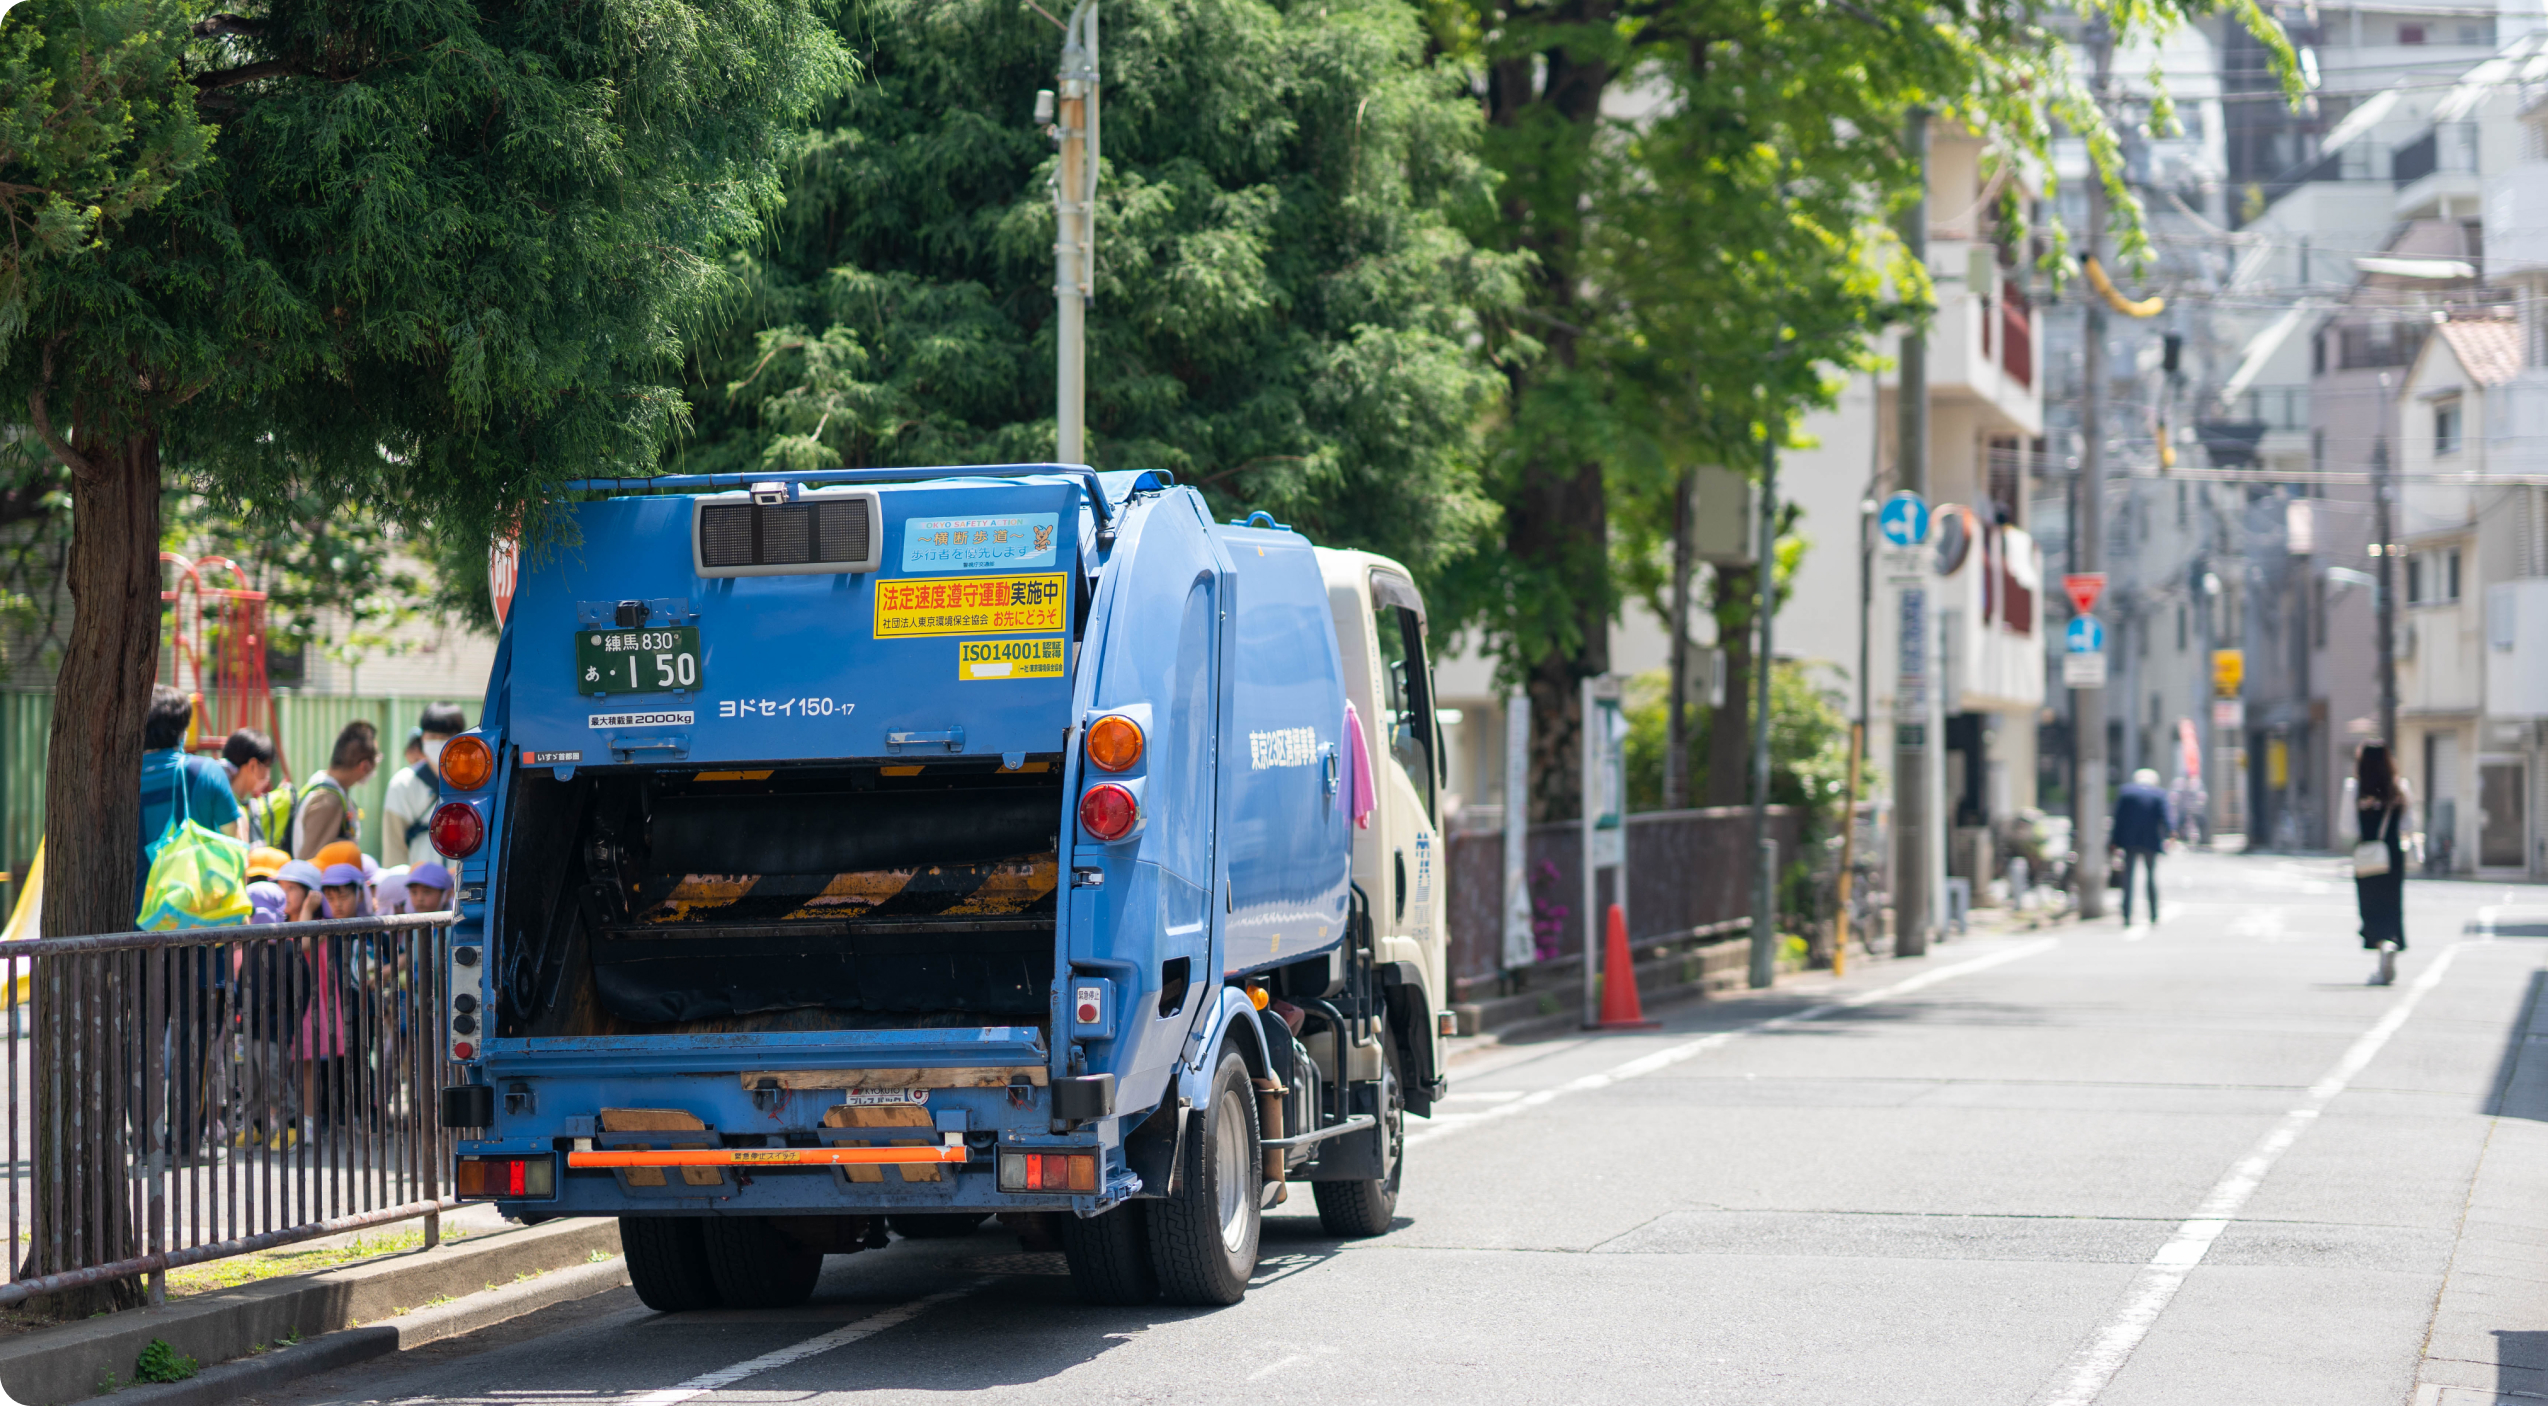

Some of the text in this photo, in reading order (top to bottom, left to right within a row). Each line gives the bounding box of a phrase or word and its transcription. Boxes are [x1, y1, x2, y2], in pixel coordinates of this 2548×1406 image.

[921, 518, 1024, 529] TOKYO SAFETY ACTION
[911, 545, 1029, 561] 歩行者を優先します
[993, 608, 1058, 627] お先にどうぞ
[962, 642, 1041, 662] ISO14001
[865, 1087, 900, 1095] KYOKUTO
